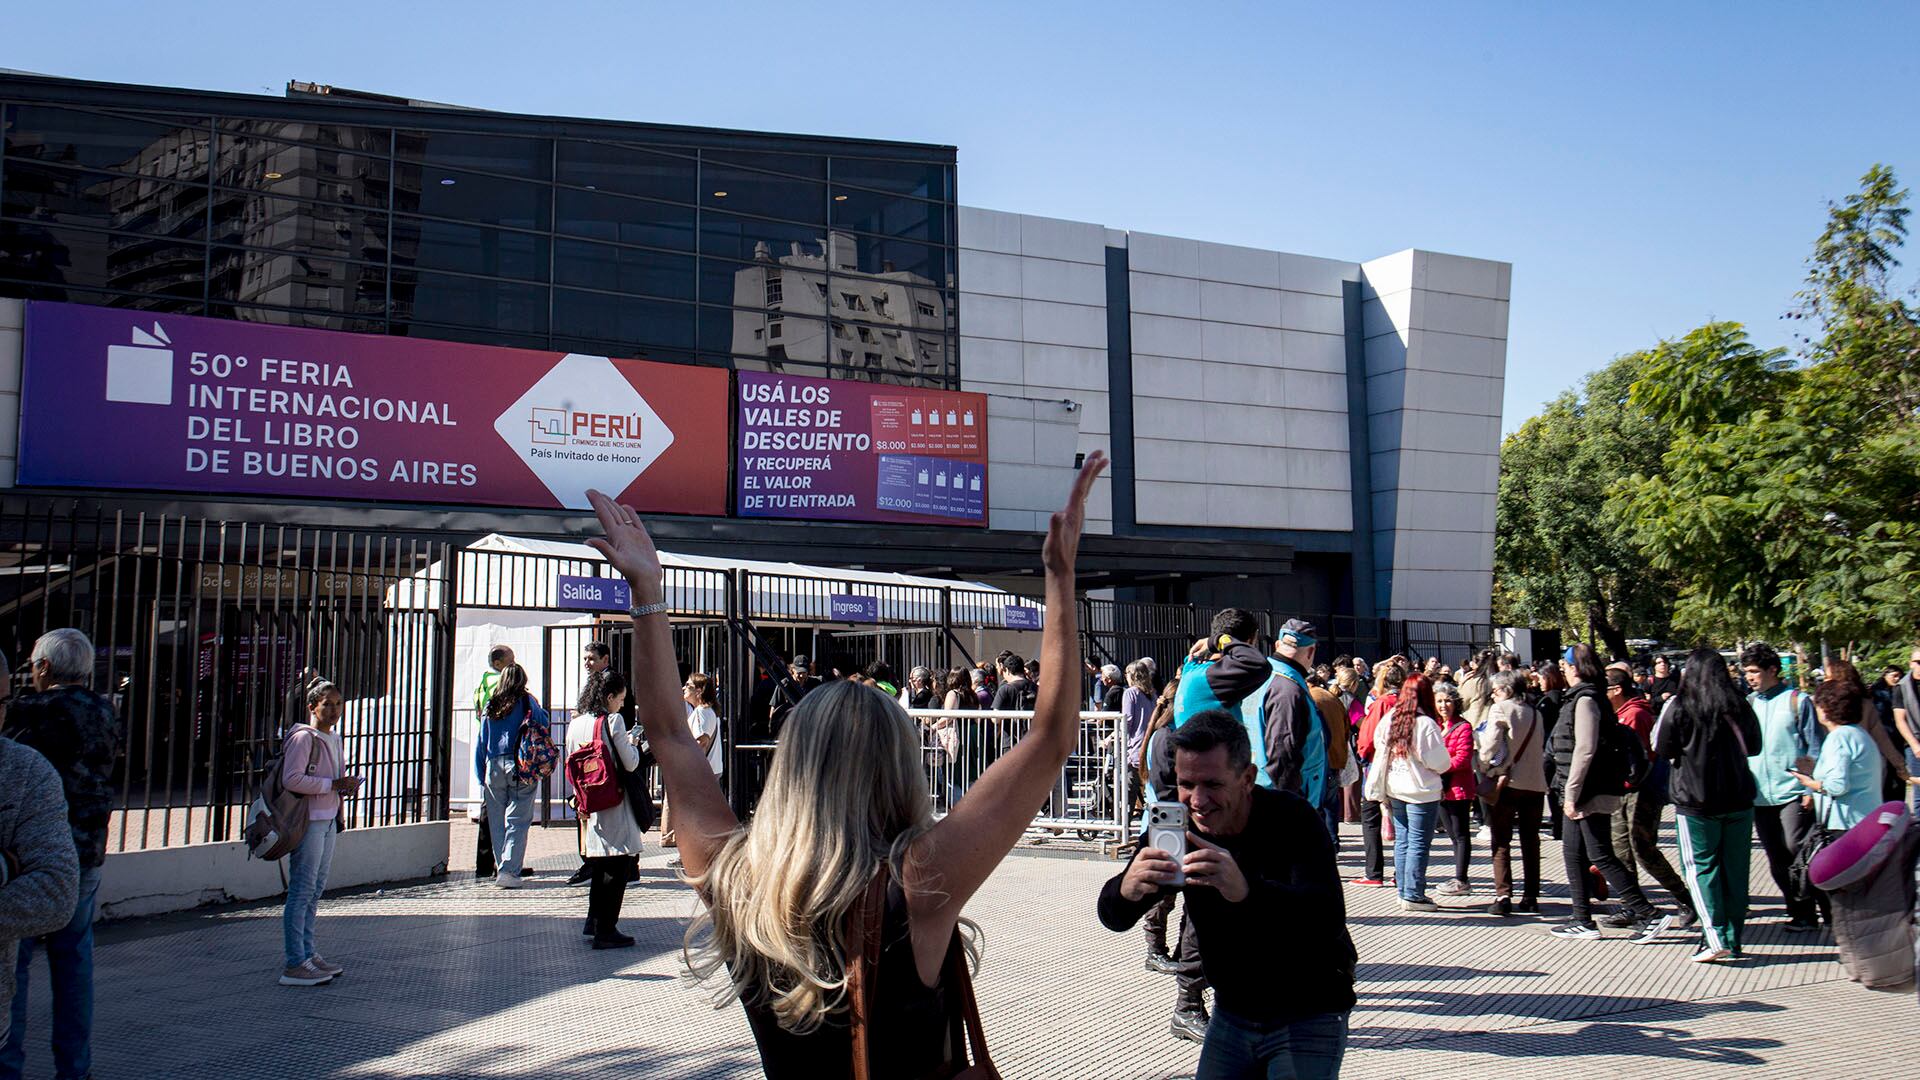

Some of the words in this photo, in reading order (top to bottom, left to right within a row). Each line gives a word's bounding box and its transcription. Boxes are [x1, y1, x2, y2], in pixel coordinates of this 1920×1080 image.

[190, 351, 248, 378] 50°
[261, 358, 354, 389] FERIA
[742, 379, 786, 403] USÁ
[790, 385, 831, 405] LOS
[189, 383, 457, 426] INTERNACIONAL
[572, 412, 642, 440] PERÚ
[744, 407, 811, 427] VALES
[814, 409, 842, 428] DE
[187, 415, 251, 443] DEL
[264, 421, 359, 449] LIBRO
[743, 431, 871, 451] DESCUENTO
[876, 441, 906, 450] $8.000
[530, 448, 552, 458] País
[554, 450, 594, 461] Invitado
[597, 453, 609, 462] de
[611, 454, 641, 463] Honor
[743, 457, 755, 471] Y
[757, 454, 832, 471] RECUPERÁ
[186, 448, 230, 473] DE
[243, 451, 378, 482] BUENOS
[389, 460, 477, 486] AIRES
[743, 476, 761, 489] EL
[764, 476, 812, 489] VALOR
[744, 495, 764, 509] DE
[767, 495, 787, 508] TU
[789, 494, 856, 508] ENTRADA
[879, 497, 912, 509] $12.000
[202, 576, 231, 588] Oce
[562, 583, 602, 601] Salida
[832, 599, 863, 615] Ingreso
[1006, 607, 1026, 619] Ingreso
